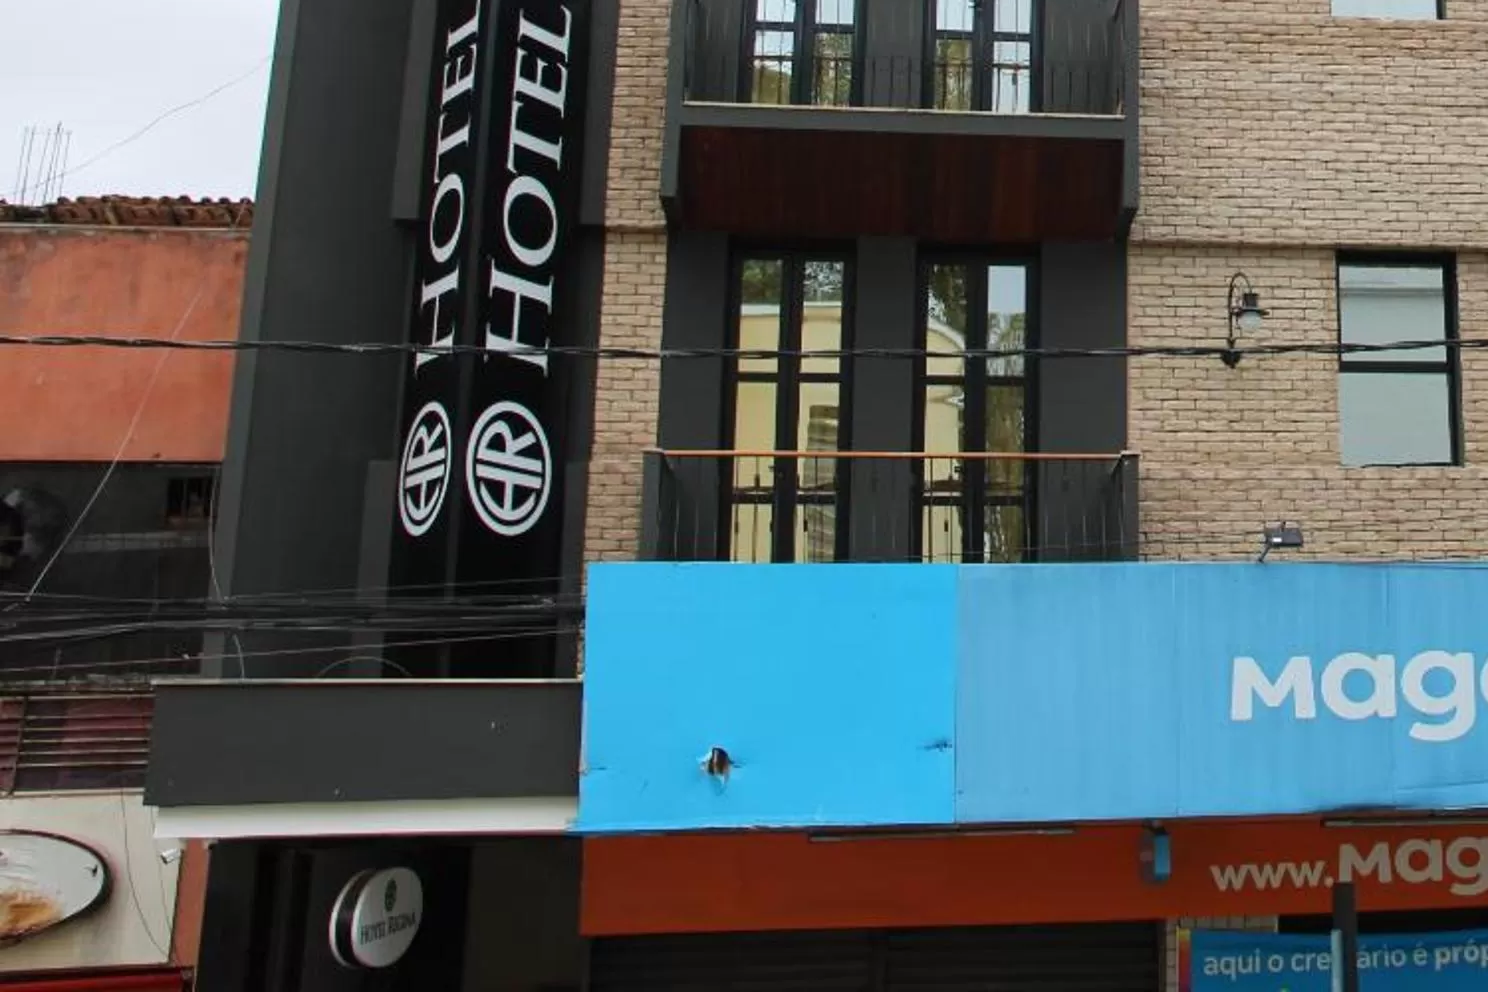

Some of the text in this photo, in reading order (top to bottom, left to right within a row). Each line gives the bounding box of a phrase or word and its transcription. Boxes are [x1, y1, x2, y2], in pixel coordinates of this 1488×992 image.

[483, 4, 573, 379] HOTEL
[1203, 946, 1262, 982] aqui
[1267, 953, 1285, 973] o
[1290, 943, 1407, 973] creário
[1412, 939, 1429, 968] é
